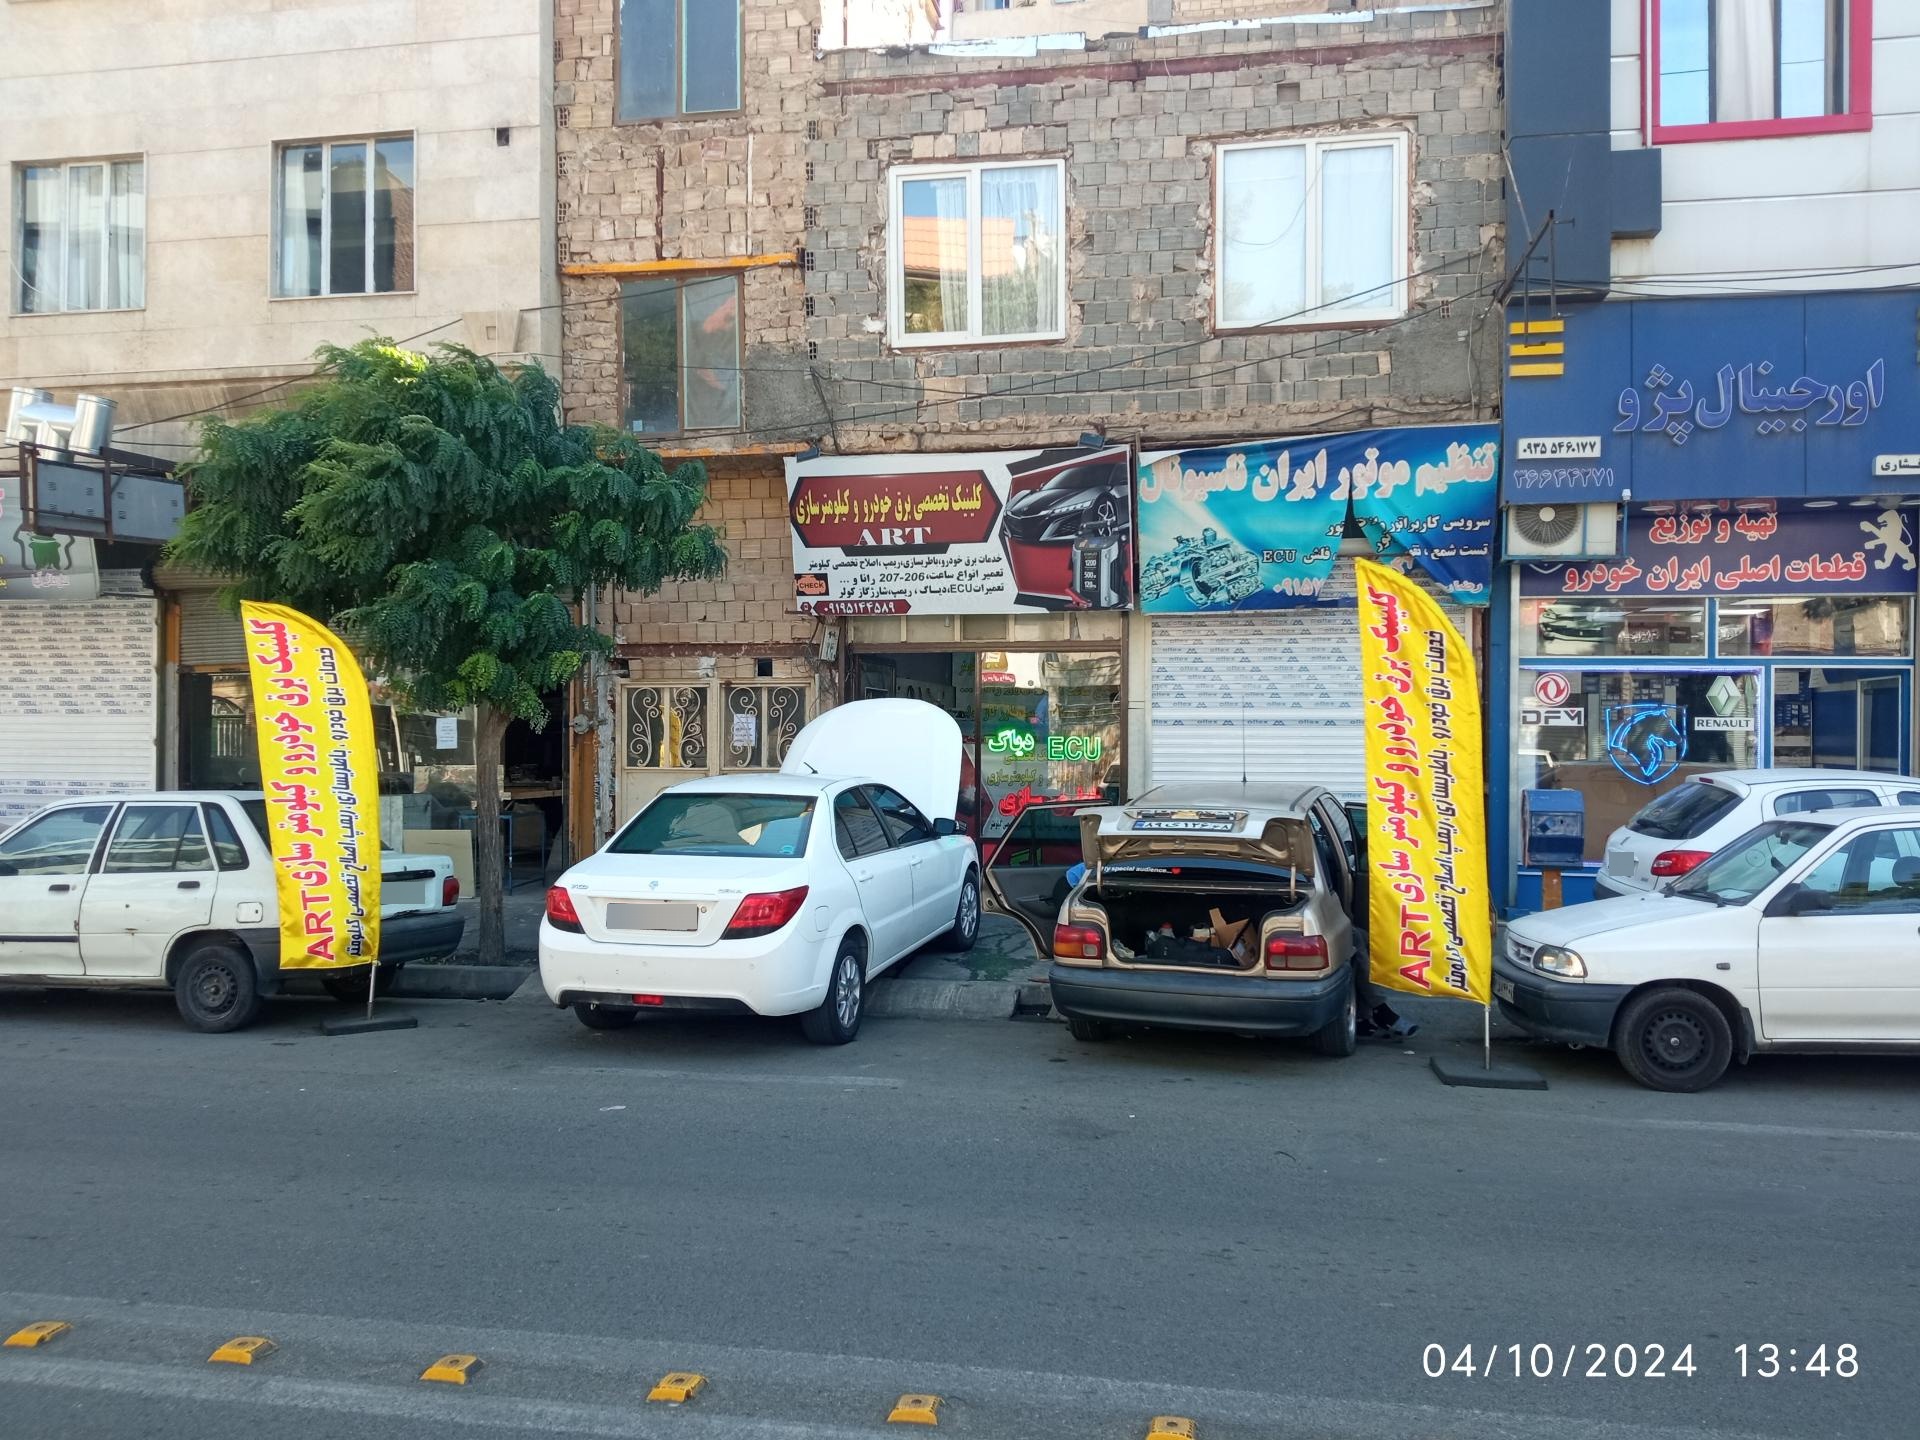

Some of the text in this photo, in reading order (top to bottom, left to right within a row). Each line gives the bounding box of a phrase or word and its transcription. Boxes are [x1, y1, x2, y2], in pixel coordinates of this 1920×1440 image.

[1612, 358, 1885, 445] اورجینال پژو
[1252, 448, 1327, 502] ایران
[1331, 448, 1410, 499] موتور
[1416, 441, 1496, 496] تنظیم
[853, 499, 859, 523] و
[863, 488, 892, 523] خودرو
[894, 491, 911, 521] برق
[914, 486, 949, 521] تخصصی
[951, 483, 983, 519] کلینیک
[856, 526, 931, 547] ART
[1442, 517, 1491, 532] سرویس
[1649, 511, 1778, 545] تهیه و توزیع
[832, 559, 858, 571] تخصصی
[964, 556, 977, 567] برق
[978, 554, 1003, 564] خدمات
[1262, 549, 1296, 564] ECU
[1431, 544, 1456, 560] شمع
[1459, 543, 1488, 557] تست
[956, 569, 979, 581] انواع
[981, 568, 1004, 581] تعمیر
[1562, 551, 1867, 592] قطعات اصلی ایران خودرو
[823, 601, 895, 614] ۰۹۱۹۵۱۴۴۵۸۹
[1367, 586, 1409, 652] کلینیک
[248, 619, 300, 674] کلینیک
[1423, 630, 1445, 674] خدمات
[315, 647, 339, 685] خدمات
[1375, 655, 1412, 693] برق
[266, 678, 309, 707] برق
[322, 687, 347, 706] برق
[1425, 676, 1452, 700] برق
[324, 709, 350, 741] خودرو
[1370, 696, 1418, 761] خودرو
[1425, 702, 1453, 740] خودرو
[1521, 708, 1583, 726] DFM
[1696, 717, 1752, 730] RENAULT
[263, 712, 316, 762] خودرو
[1047, 735, 1102, 761] ECU
[283, 766, 317, 776] و
[1385, 763, 1420, 777] و
[341, 873, 365, 917] تخصصی
[301, 889, 335, 960] ART
[1434, 894, 1463, 947] تخصصی
[1399, 904, 1431, 990] ART
